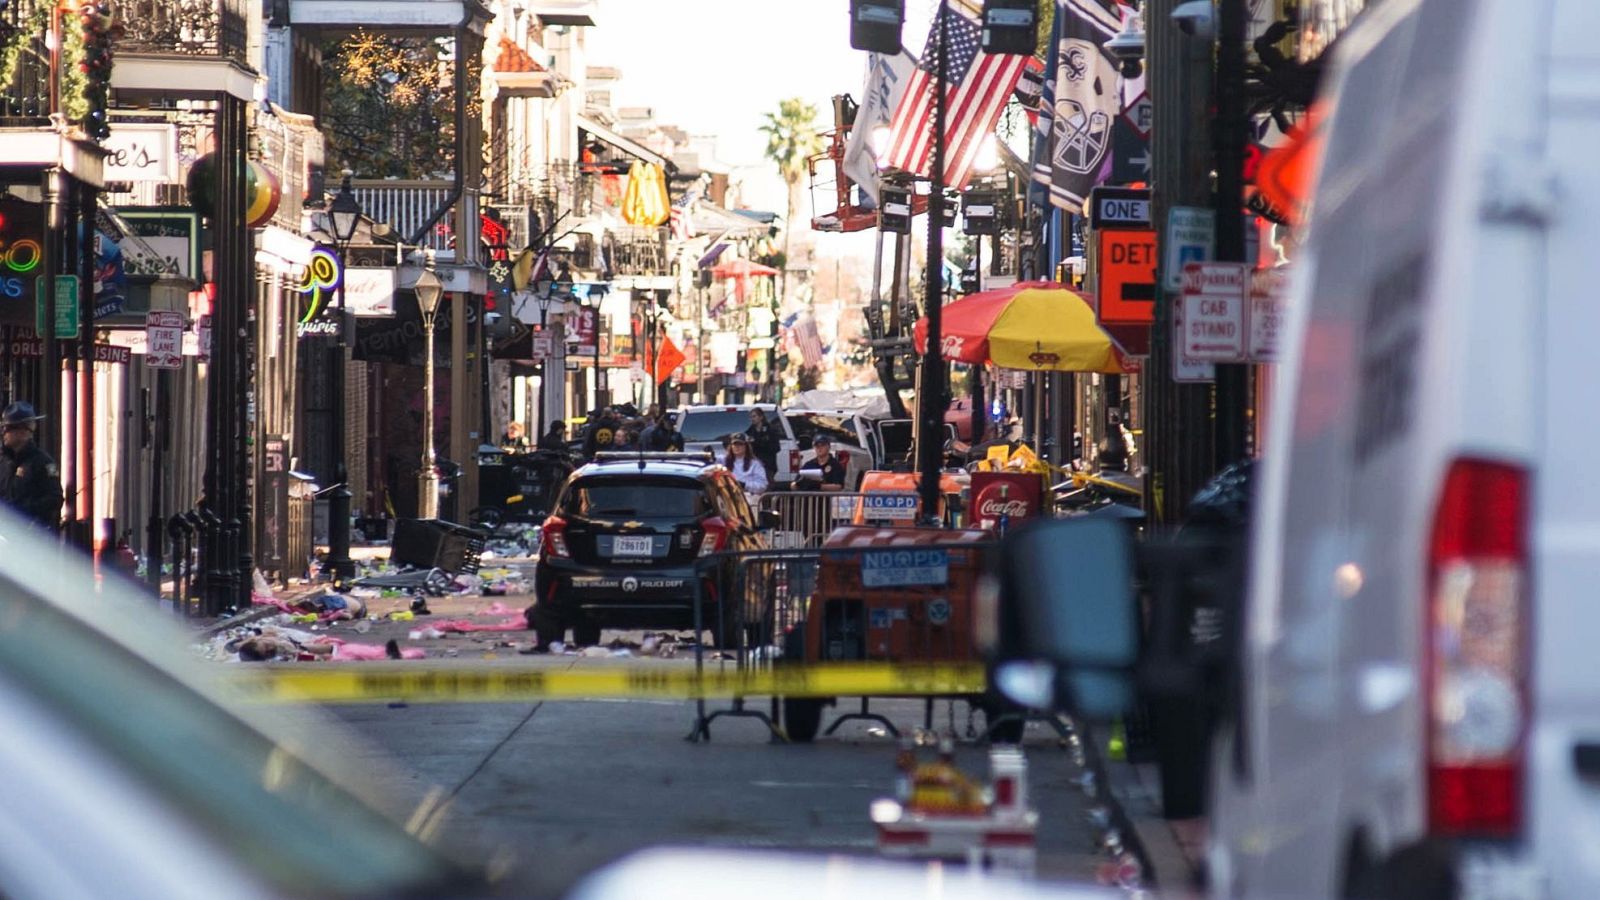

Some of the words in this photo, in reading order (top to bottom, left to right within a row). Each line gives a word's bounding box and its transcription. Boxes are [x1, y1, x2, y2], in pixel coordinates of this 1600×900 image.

[1104, 201, 1141, 219] ONE
[1200, 301, 1228, 316] CAB
[155, 330, 175, 340] FIRE
[1191, 322, 1236, 338] STAND
[153, 342, 175, 352] LANE
[640, 580, 665, 588] POLICE
[665, 580, 684, 588] DEPT
